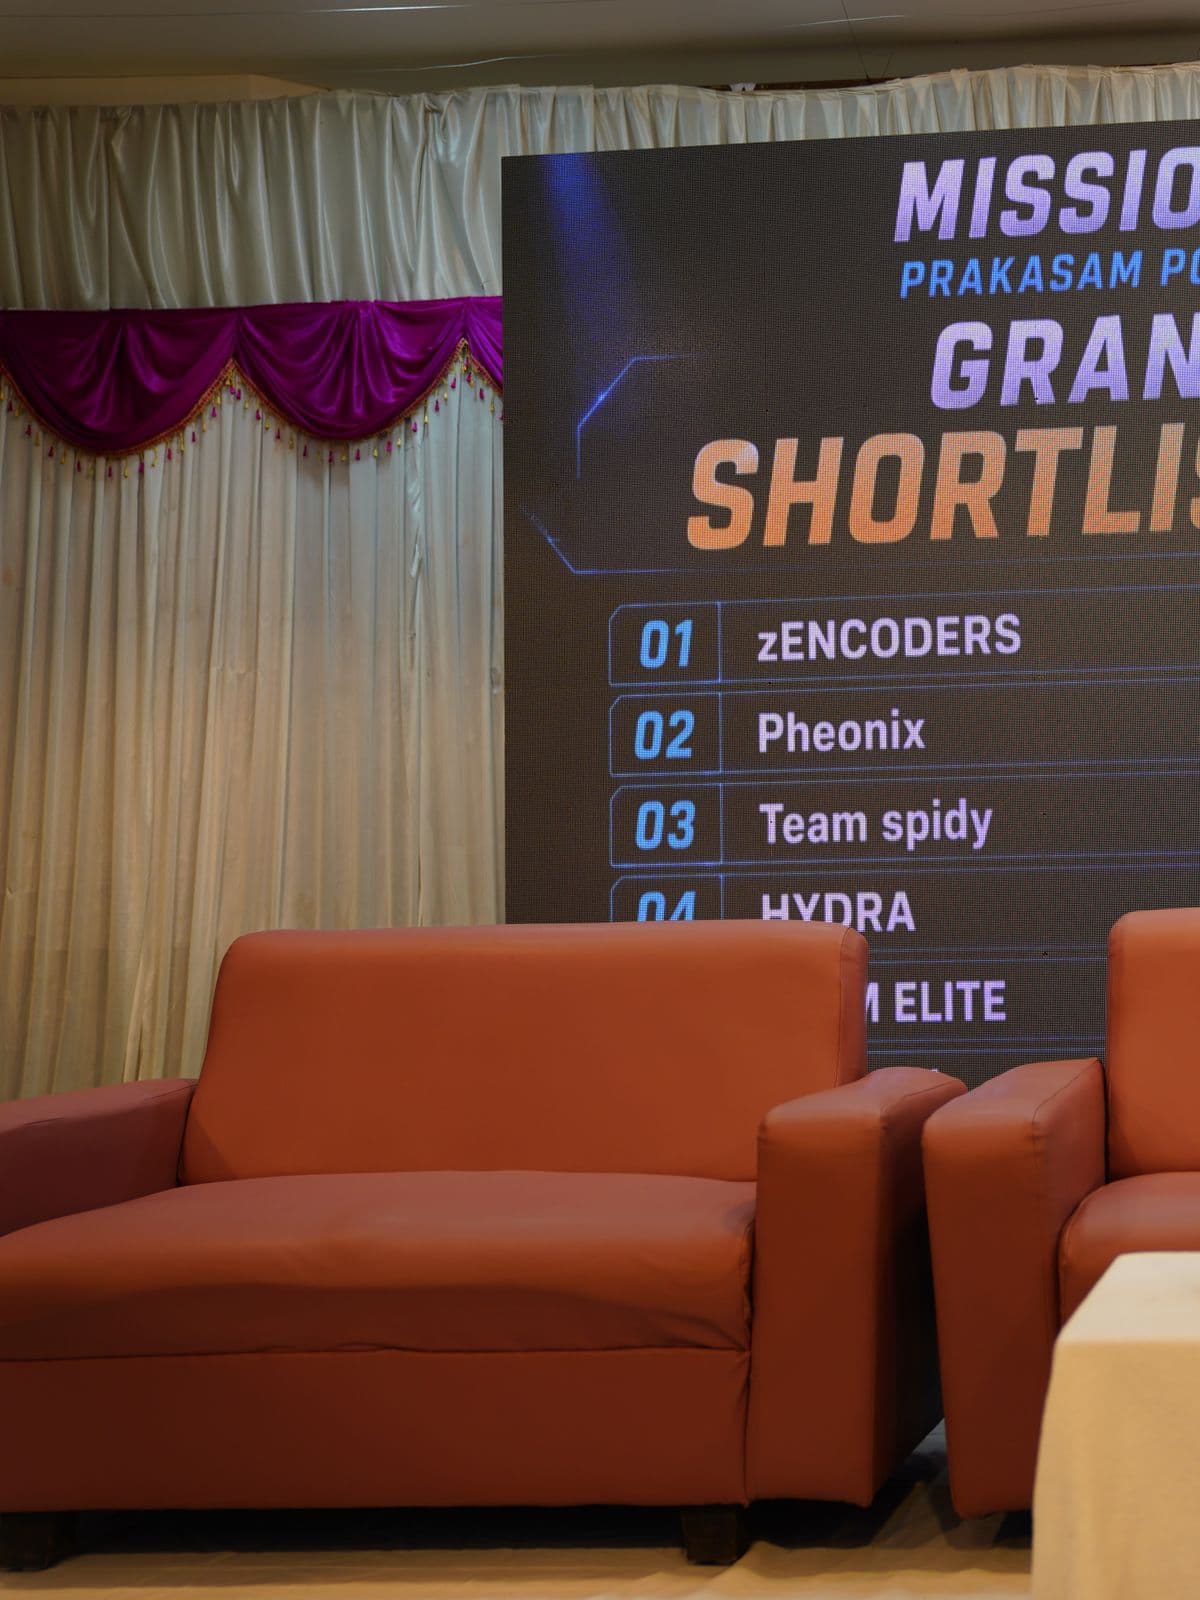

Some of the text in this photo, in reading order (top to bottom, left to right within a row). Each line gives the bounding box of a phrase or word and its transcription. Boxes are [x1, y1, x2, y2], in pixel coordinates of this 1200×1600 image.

[900, 250, 1143, 298] PRAKASAM
[640, 613, 1021, 668] 01 zENCODERS
[635, 708, 925, 759] 02 Pheonix
[635, 798, 992, 851] 03 Team spidy
[762, 891, 916, 932] HYDRA
[895, 980, 1006, 1022] ELITE
